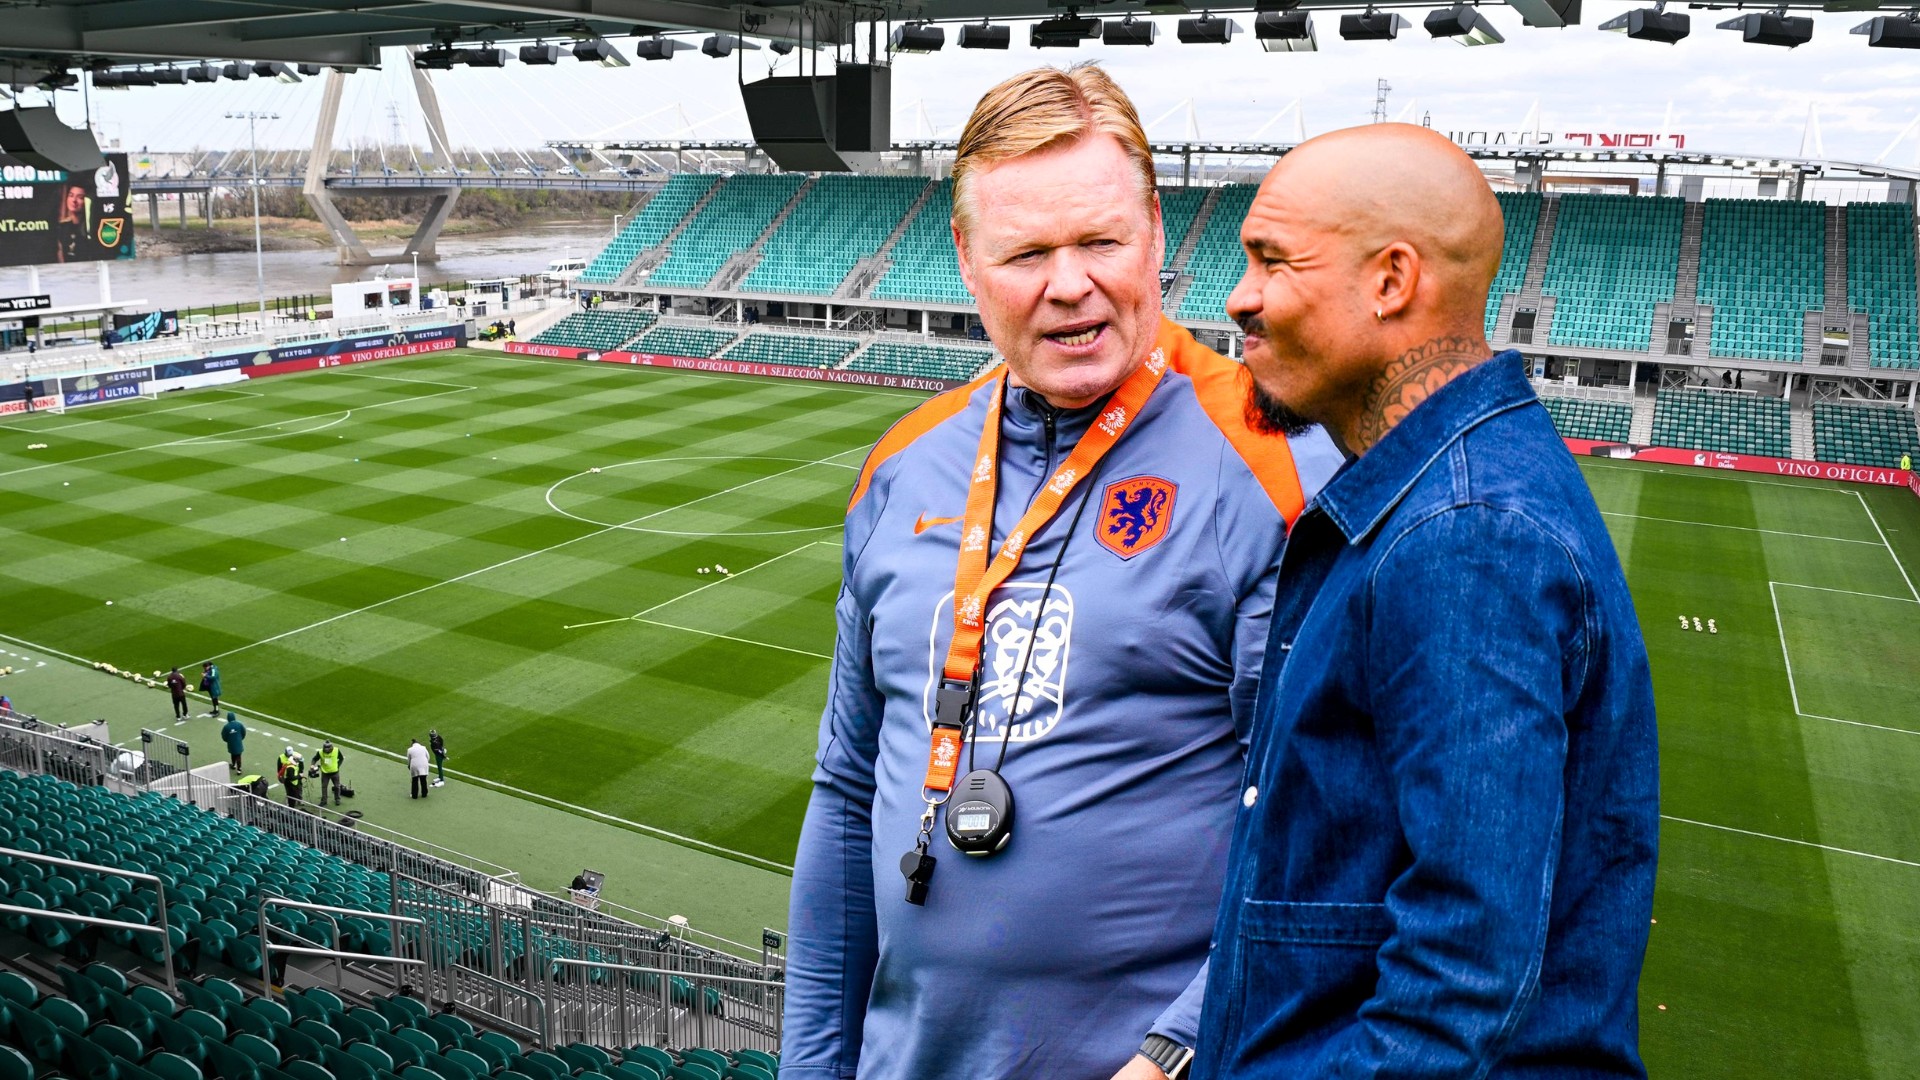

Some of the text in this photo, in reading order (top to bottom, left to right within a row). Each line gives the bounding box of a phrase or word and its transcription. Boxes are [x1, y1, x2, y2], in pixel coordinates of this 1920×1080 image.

[3, 165, 36, 181] ORO
[5, 186, 34, 199] NOW
[103, 203, 115, 213] VS
[11, 298, 36, 309] YETI
[414, 330, 442, 339] MEXTOUR
[279, 348, 312, 358] MEXTOUR
[352, 351, 372, 362] VINO
[374, 347, 405, 359] OFICIAL
[407, 345, 418, 354] DE
[420, 343, 430, 352] LA
[514, 345, 525, 353] DE
[527, 344, 559, 357] MÉXICO
[106, 370, 148, 381] MEXTOUR
[672, 358, 944, 391] VINO OFICIAL DE LA SELECCIÓN NACIONAL DE MÉXICO
[105, 386, 136, 398] ULTRA
[33, 397, 56, 408] KING
[1098, 422, 1116, 437] KNVB
[1776, 461, 1900, 485] VINO OFICIAL
[764, 937, 778, 947] 203
